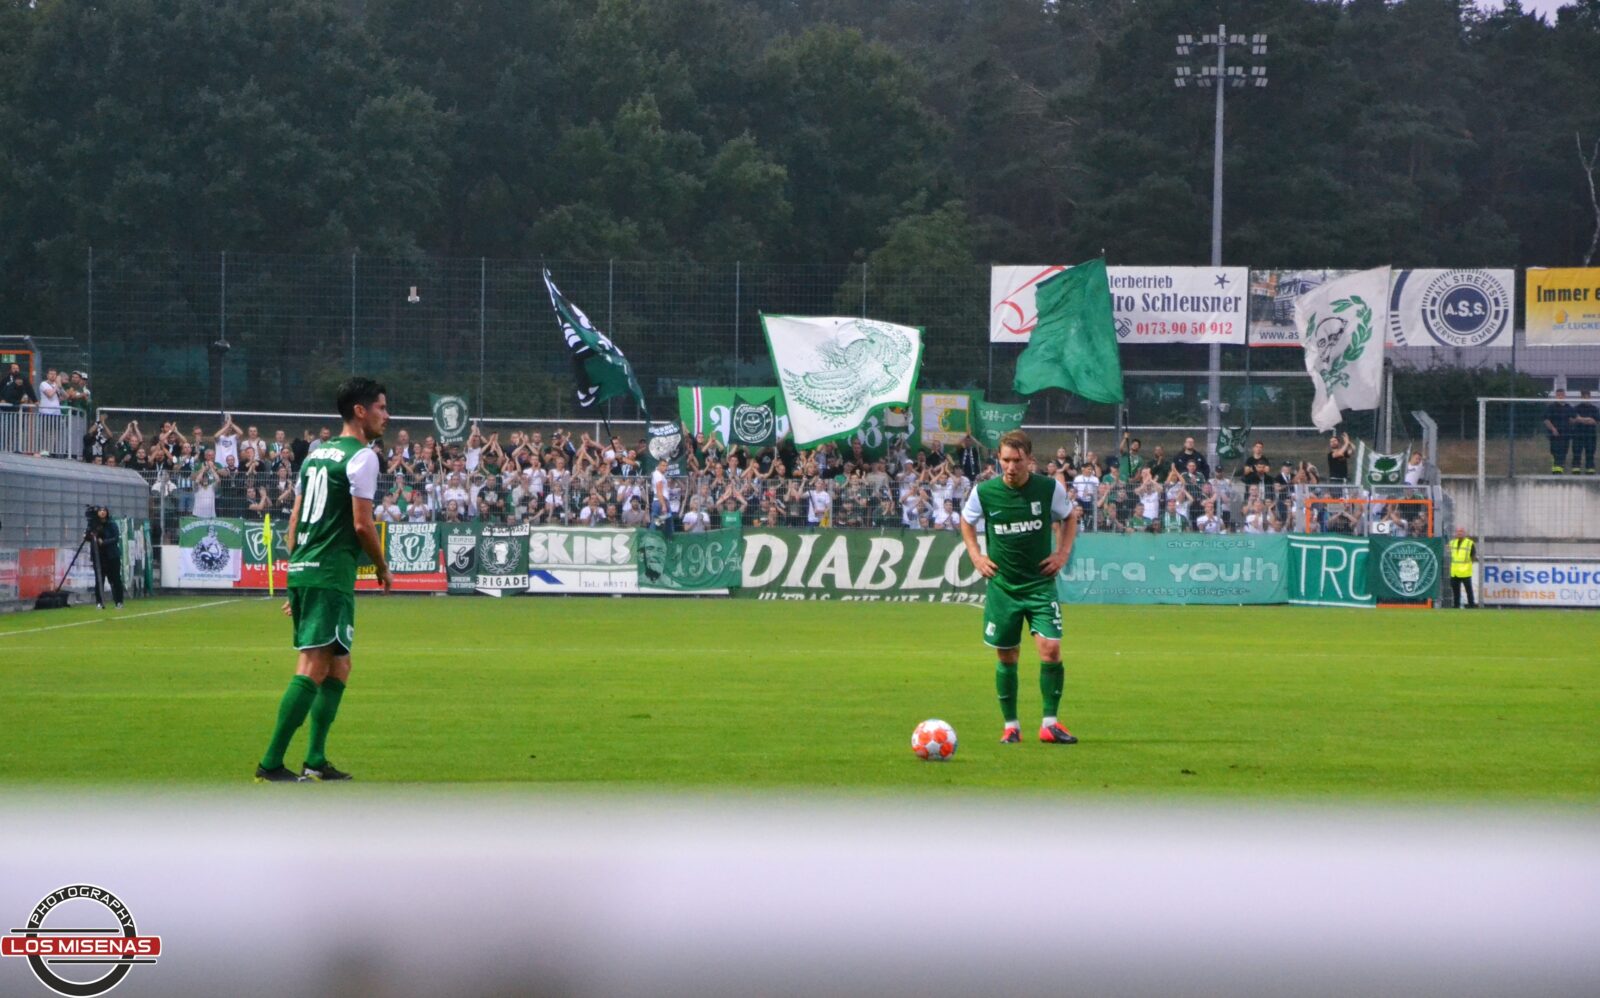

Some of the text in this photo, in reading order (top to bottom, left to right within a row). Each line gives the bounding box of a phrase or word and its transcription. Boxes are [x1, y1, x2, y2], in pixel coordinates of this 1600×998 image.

[1434, 274, 1498, 299] ALL STREETS
[1537, 285, 1590, 303] Immer
[1142, 293, 1242, 313] Schleusner
[1136, 322, 1187, 335] 0173.90
[1210, 322, 1233, 335] 912
[1433, 321, 1496, 345] SERVICE GMBH
[302, 466, 328, 524] 10
[388, 523, 437, 534] SEKTION
[1377, 523, 1386, 533] C
[529, 533, 632, 565] SKINS
[672, 539, 743, 578] 1964
[388, 561, 436, 572] UMLAND
[1291, 543, 1373, 601] TRC
[477, 576, 528, 588] BRIGADE
[1484, 588, 1556, 600] Lufthansa
[1560, 588, 1584, 603] City
